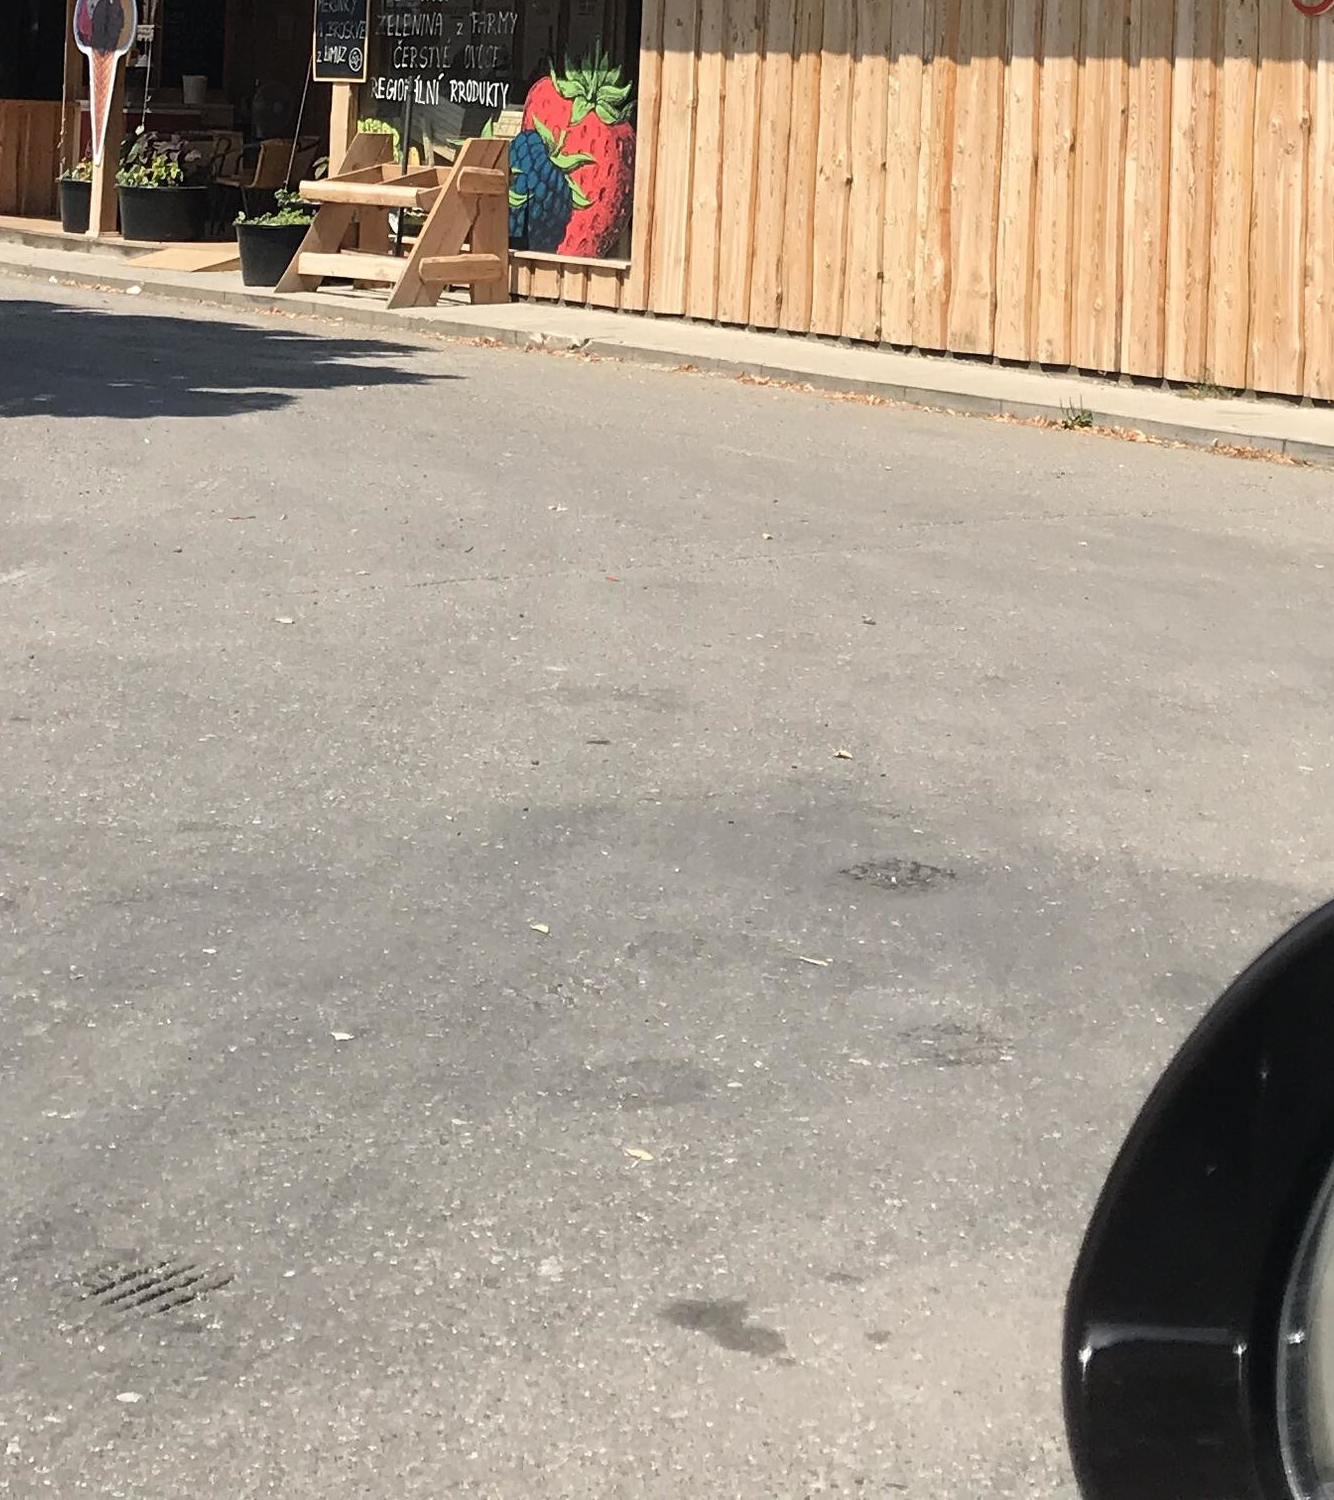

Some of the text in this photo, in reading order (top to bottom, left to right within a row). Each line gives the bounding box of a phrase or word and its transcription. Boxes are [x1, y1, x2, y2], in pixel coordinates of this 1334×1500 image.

[375, 12, 443, 37] ZELENINA
[470, 11, 518, 36] FARMY
[393, 38, 451, 68] ČERSTVÉ
